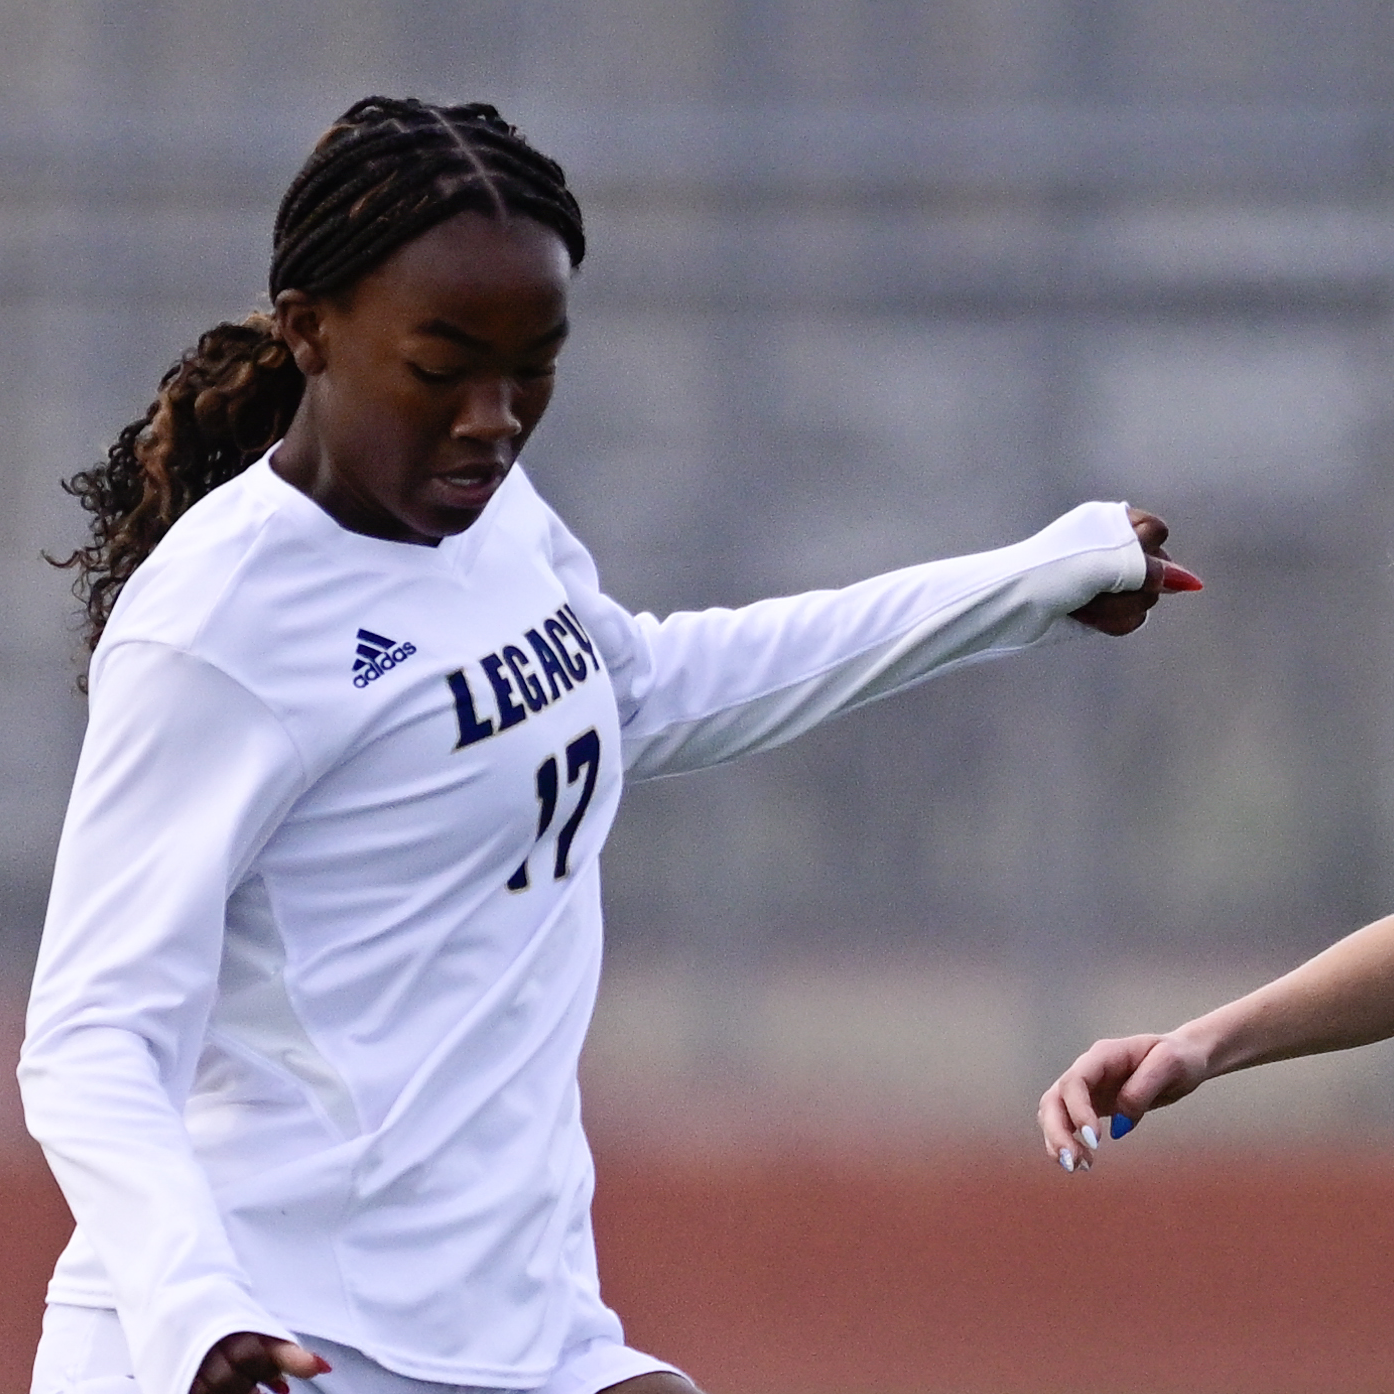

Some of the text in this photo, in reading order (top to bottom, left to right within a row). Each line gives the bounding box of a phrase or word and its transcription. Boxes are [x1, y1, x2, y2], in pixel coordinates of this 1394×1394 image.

[352, 641, 417, 688] adidas
[446, 603, 600, 753] LEGACY
[506, 728, 601, 891] 17
